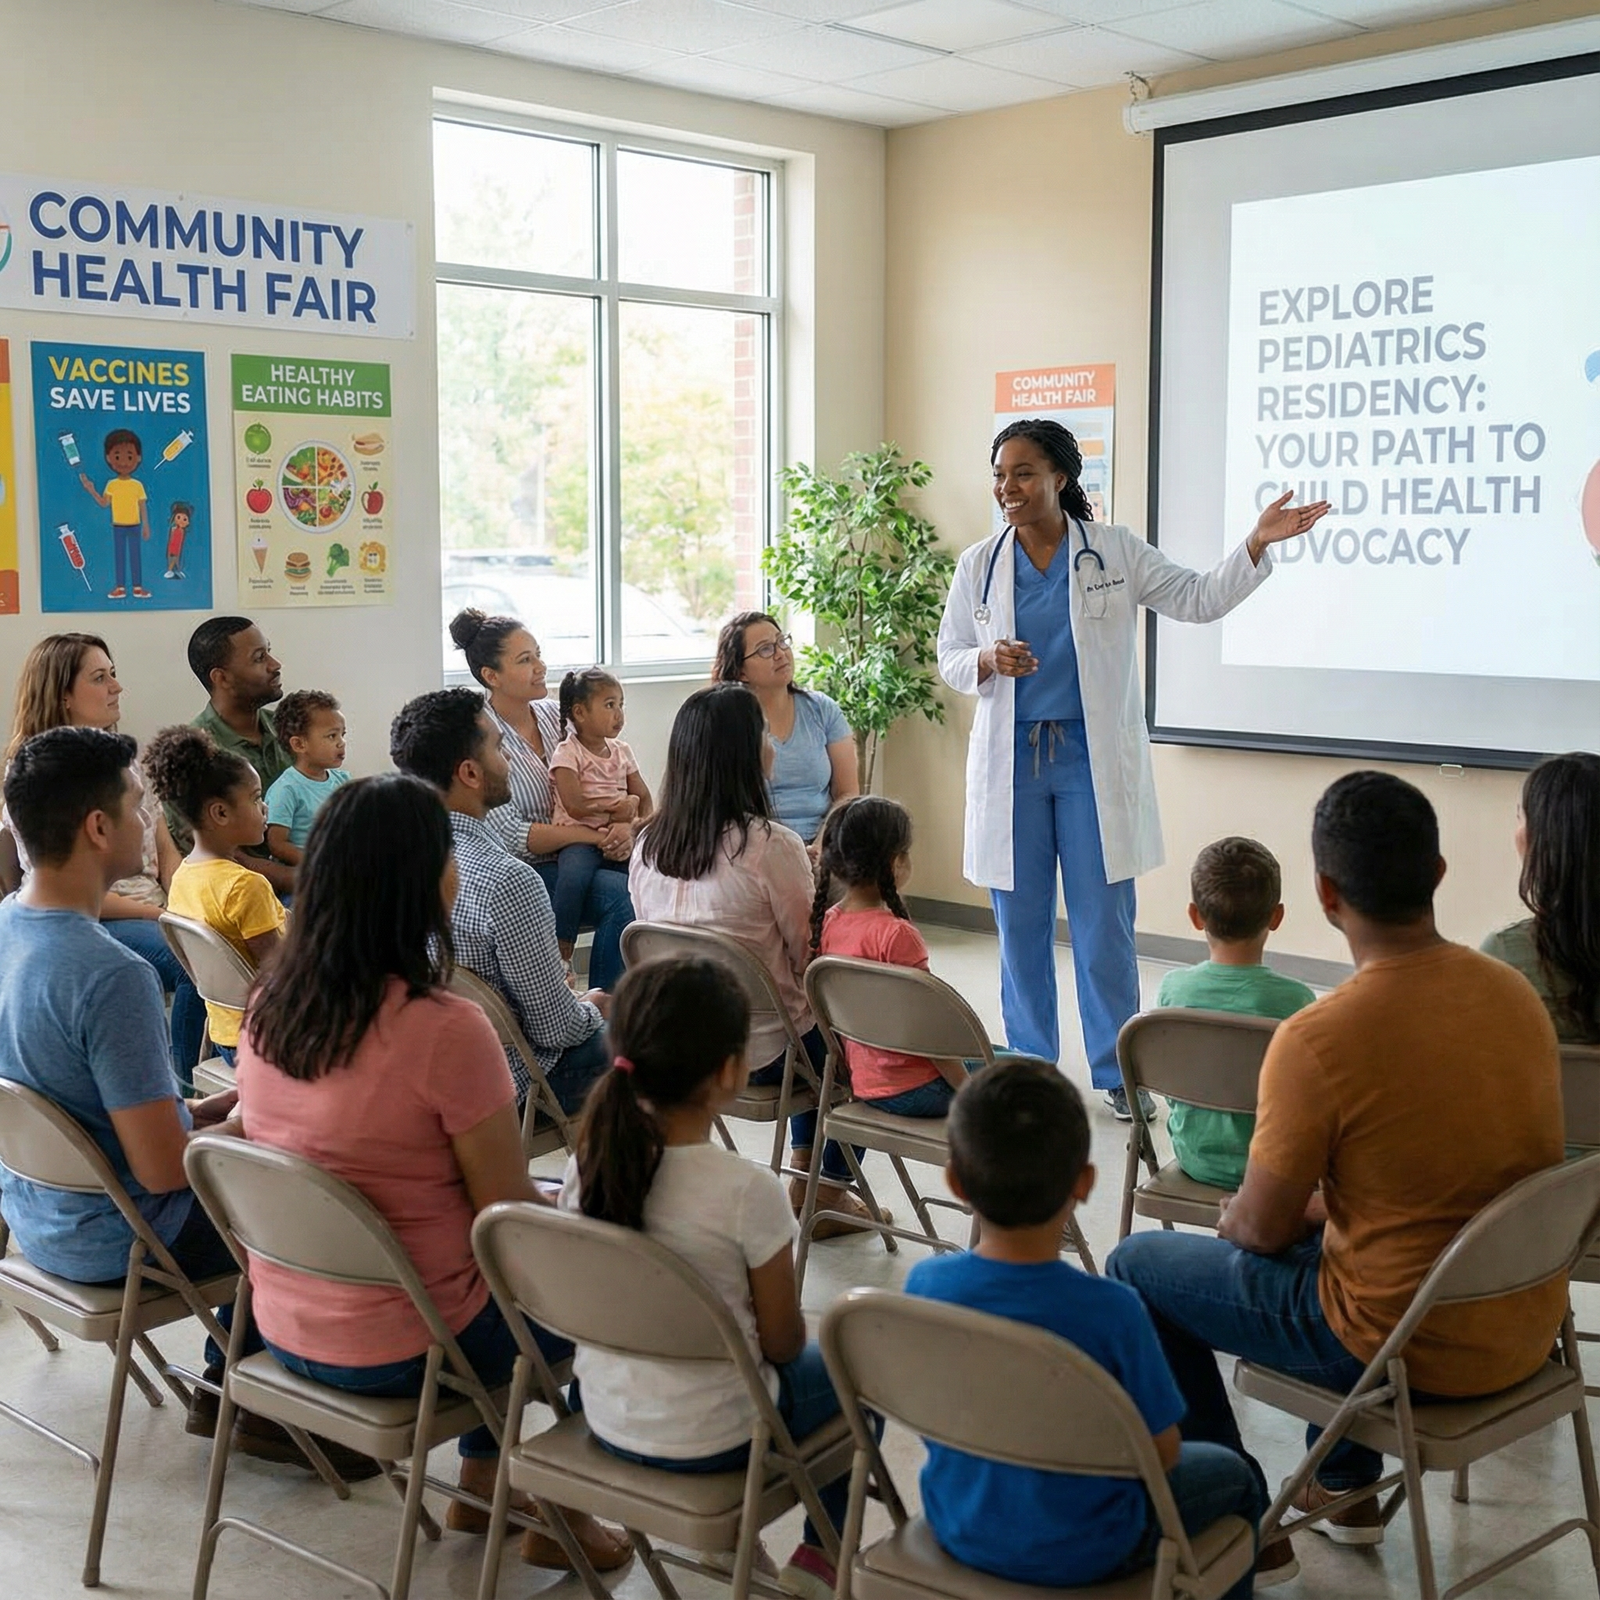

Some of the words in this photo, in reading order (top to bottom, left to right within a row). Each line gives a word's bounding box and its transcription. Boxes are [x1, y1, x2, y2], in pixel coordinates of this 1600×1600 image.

[29, 191, 364, 268] COMMUNITY
[32, 249, 246, 312] HEALTH
[265, 273, 377, 323] FAIR
[1259, 275, 1434, 326] EXPLORE
[1258, 322, 1487, 374] PEDIATRICS
[49, 356, 190, 386] VACCINES
[271, 364, 355, 386] HEALTHY
[1012, 370, 1095, 391] COMMUNITY
[50, 387, 115, 411] SAVE
[124, 390, 191, 414] LIVES
[242, 384, 311, 405] EATING
[317, 388, 383, 409] HABITS
[1011, 390, 1062, 408] HEALTH
[1065, 388, 1096, 404] FAIR
[1258, 374, 1486, 421] RESIDENCY:
[1255, 431, 1359, 469] YOUR
[1372, 425, 1475, 466] PATH
[1488, 422, 1546, 463] TO
[1382, 475, 1541, 516] HEALTH
[1264, 527, 1471, 566] DVOCACY
